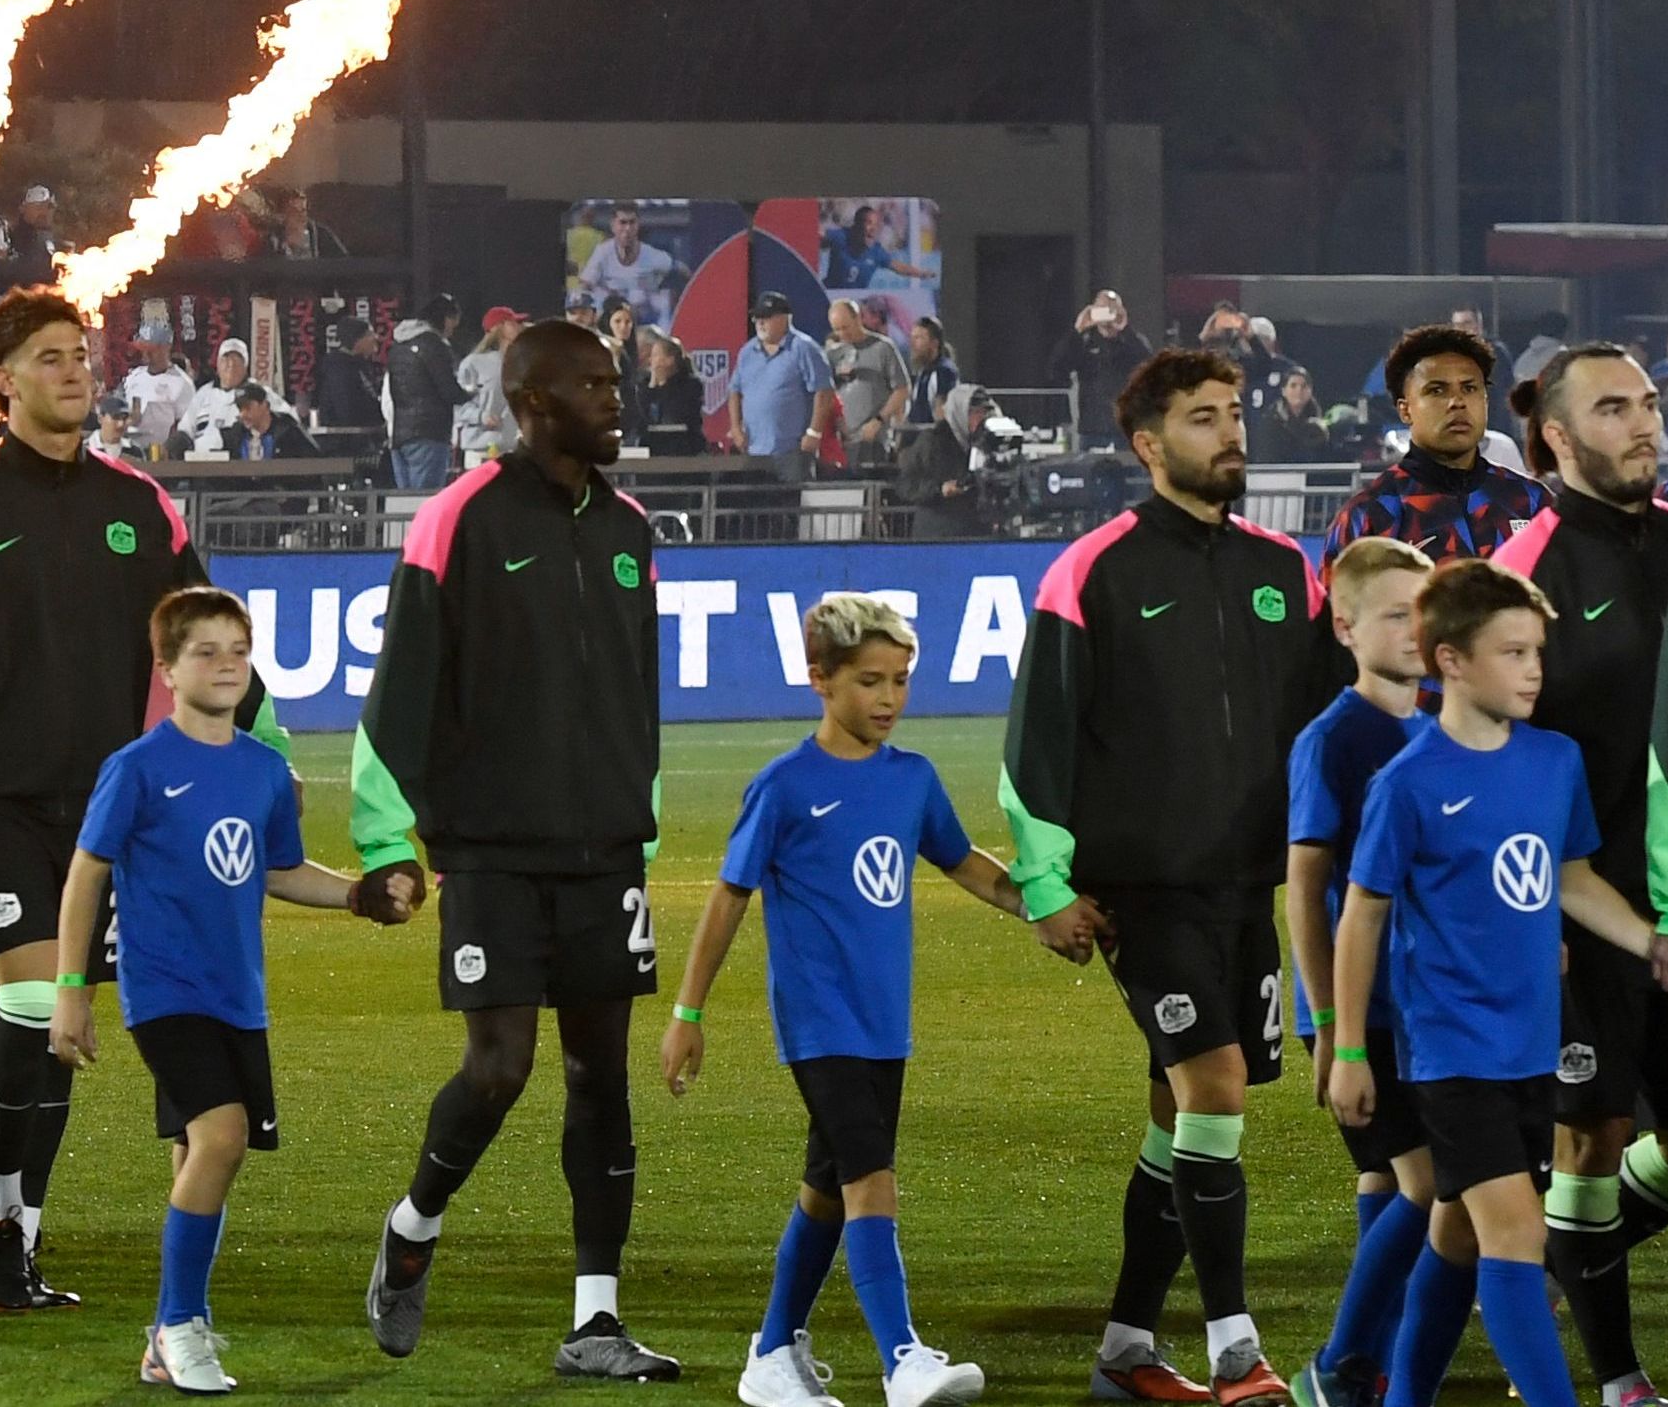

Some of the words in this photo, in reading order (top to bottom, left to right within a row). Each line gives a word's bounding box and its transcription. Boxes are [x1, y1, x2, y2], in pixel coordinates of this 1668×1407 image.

[204, 817, 254, 886] VW
[853, 835, 904, 908] VW
[1493, 833, 1552, 912] VW
